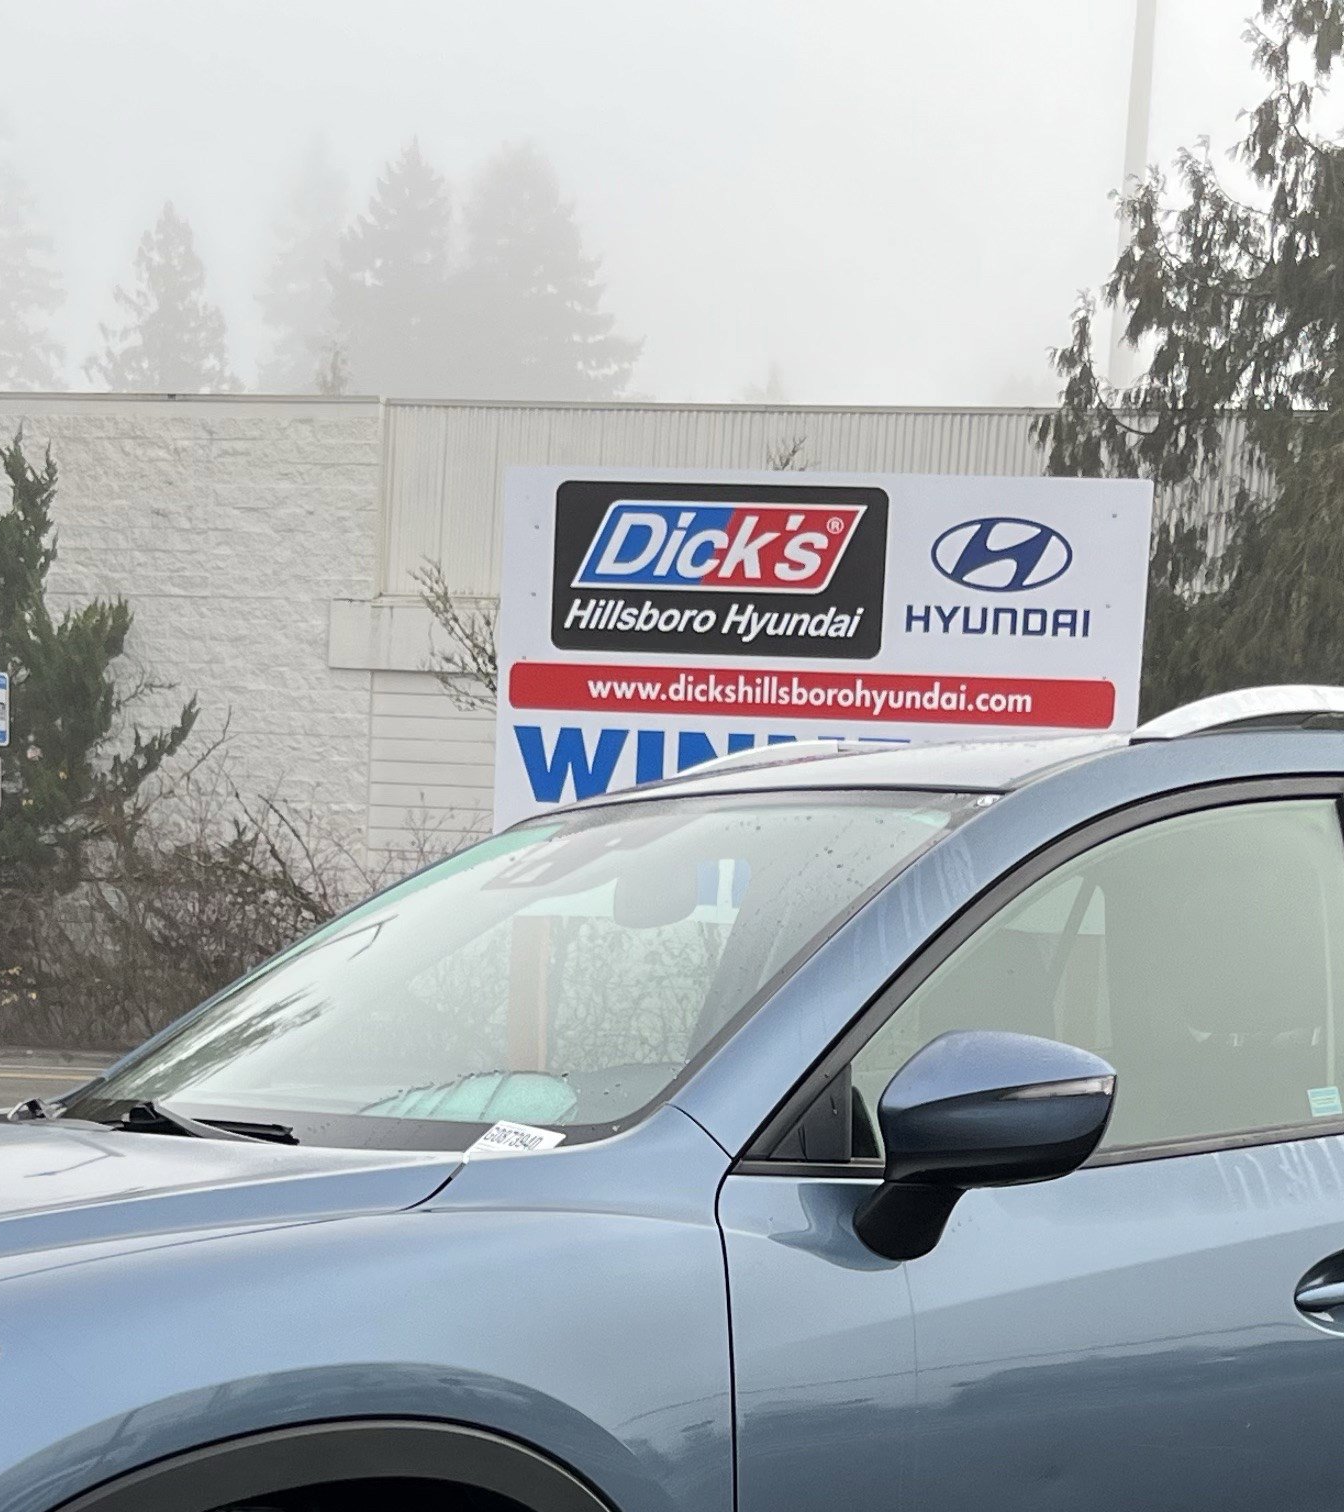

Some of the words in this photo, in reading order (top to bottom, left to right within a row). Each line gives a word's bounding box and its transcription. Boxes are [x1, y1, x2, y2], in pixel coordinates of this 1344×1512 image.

[594, 511, 829, 582] Dick's
[563, 598, 717, 633] Hillsboro
[720, 603, 866, 643] Hyundai
[904, 604, 1091, 638] HYUNDAI
[586, 673, 1033, 717] www.dickshillsborohyundai.com
